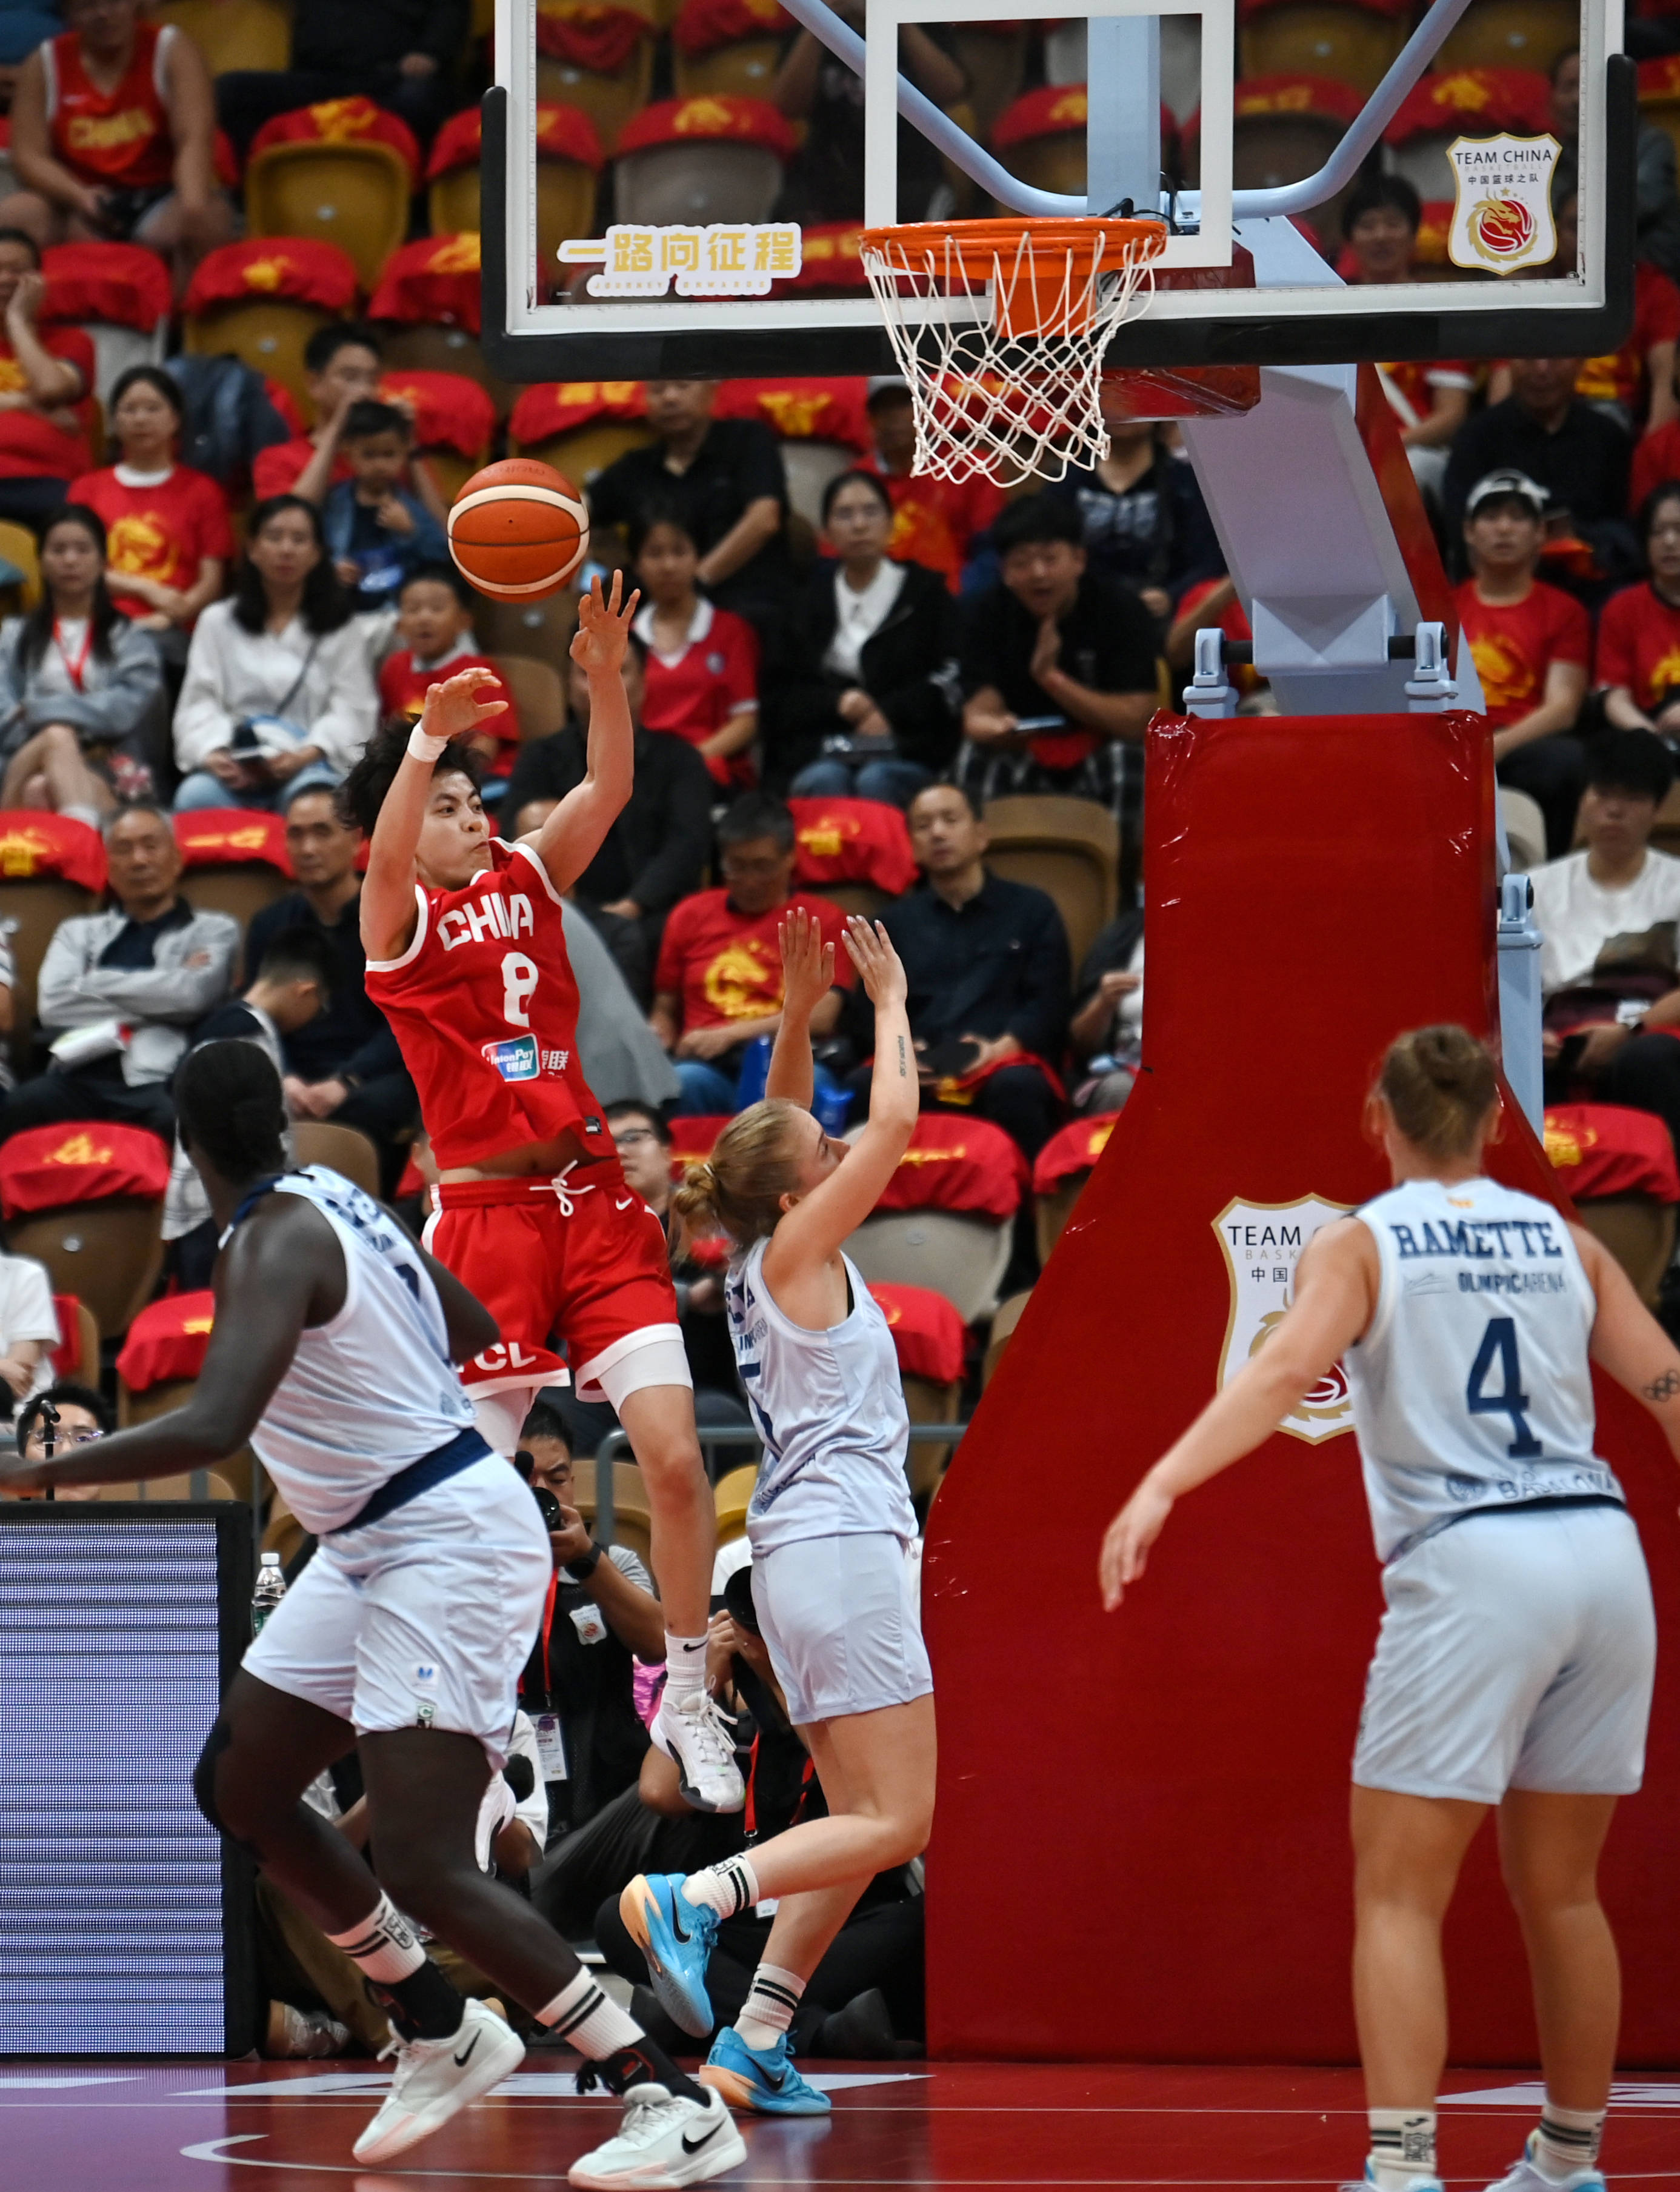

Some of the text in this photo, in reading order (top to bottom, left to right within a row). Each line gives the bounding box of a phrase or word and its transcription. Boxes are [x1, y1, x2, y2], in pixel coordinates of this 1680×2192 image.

[1455, 149, 1553, 165] TEAM CHINA
[1468, 173, 1539, 185] 中国篮球之队
[567, 231, 795, 272] 一路向征程
[501, 952, 539, 1028] 8
[1227, 1226, 1301, 1245] TEAM
[1390, 1220, 1564, 1259] RAMETTE
[1252, 1267, 1288, 1283] 中国
[456, 1342, 536, 1373] CL
[1465, 1318, 1544, 1459] 4
